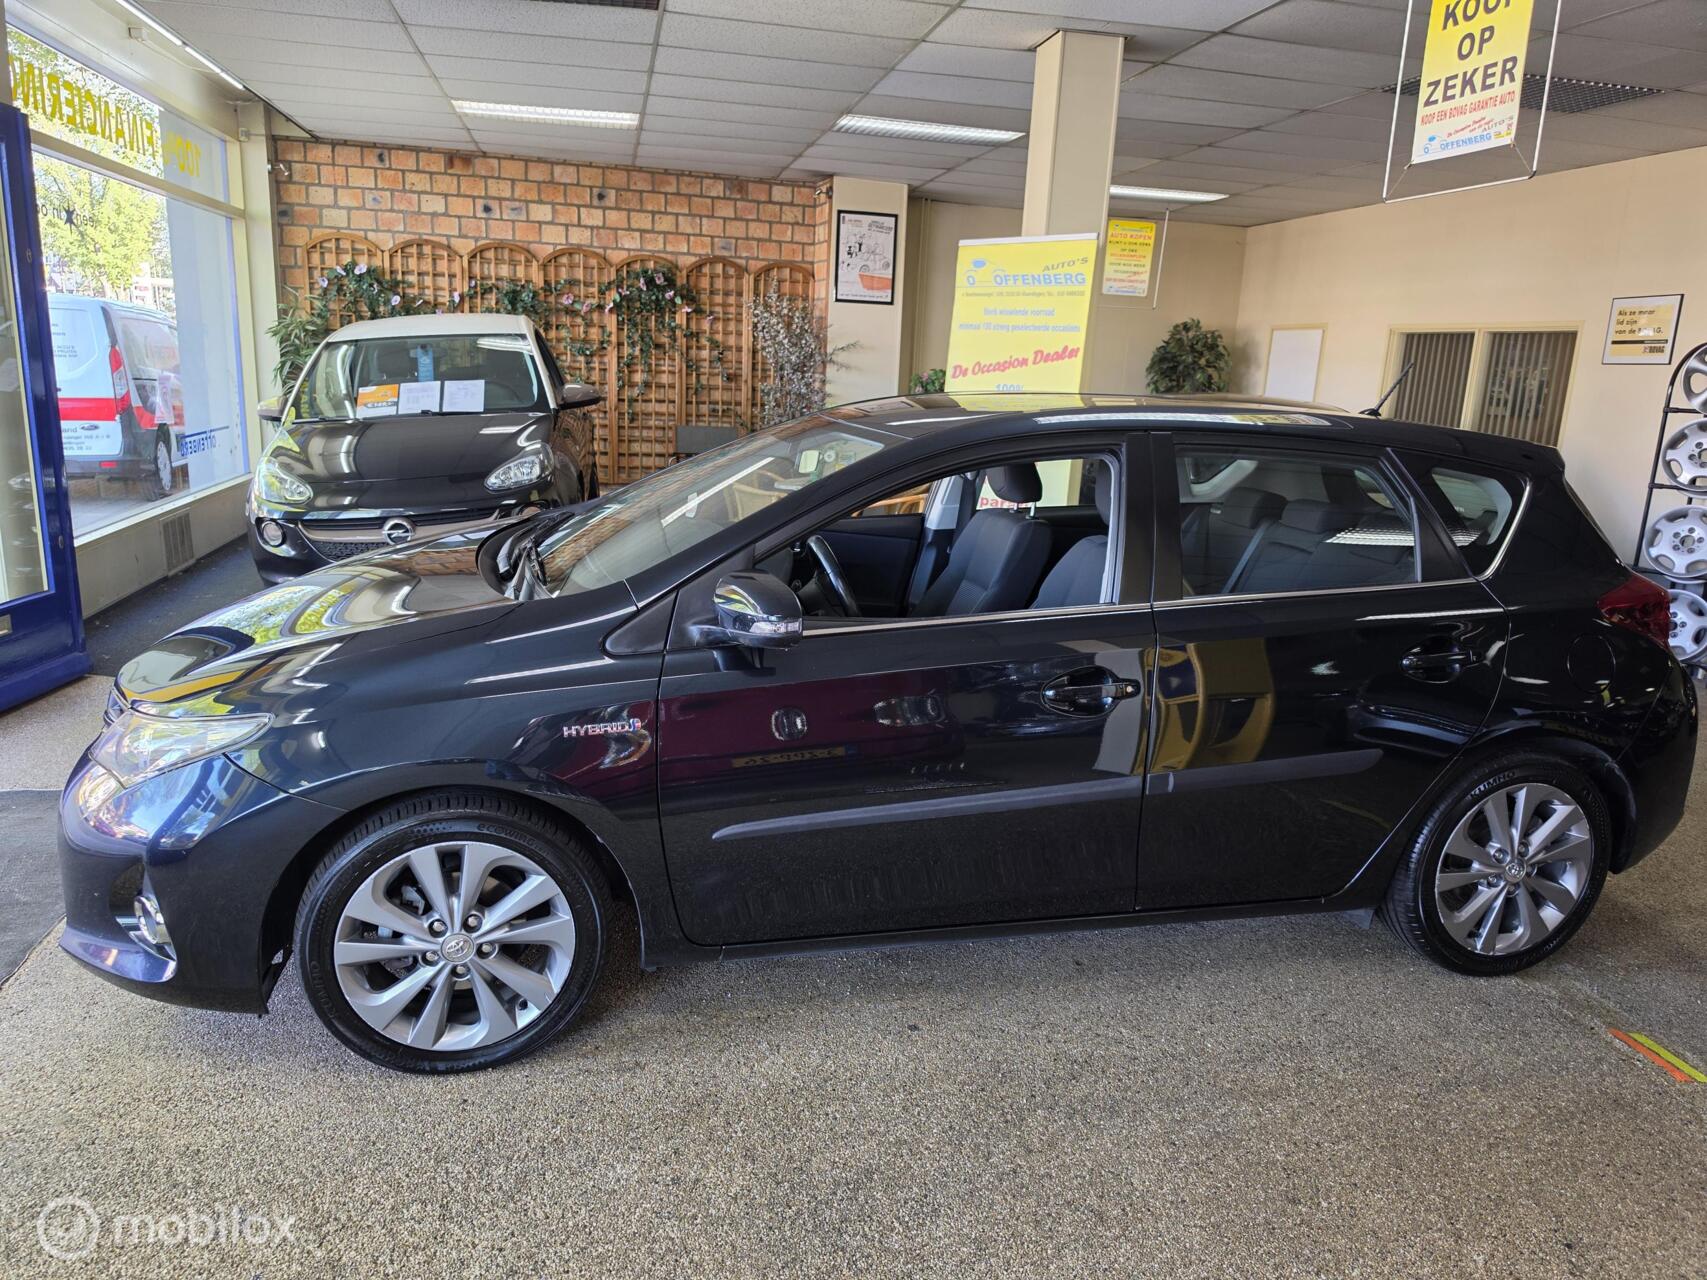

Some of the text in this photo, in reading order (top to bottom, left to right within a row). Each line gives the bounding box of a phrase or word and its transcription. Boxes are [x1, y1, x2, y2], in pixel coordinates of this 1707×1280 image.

[1442, 0, 1511, 31] KOO
[1457, 25, 1495, 61] OP
[1423, 55, 1518, 109] ZEKER
[1420, 90, 1516, 126] KOOP EEN BOVAG GARANTIE AUTO
[1440, 132, 1492, 151] OFFENBERG
[993, 272, 1087, 286] OFFENBERG
[1042, 257, 1089, 272] AUTO'S
[951, 344, 1081, 379] De Occasion Dealer
[563, 721, 630, 738] HYBRID
